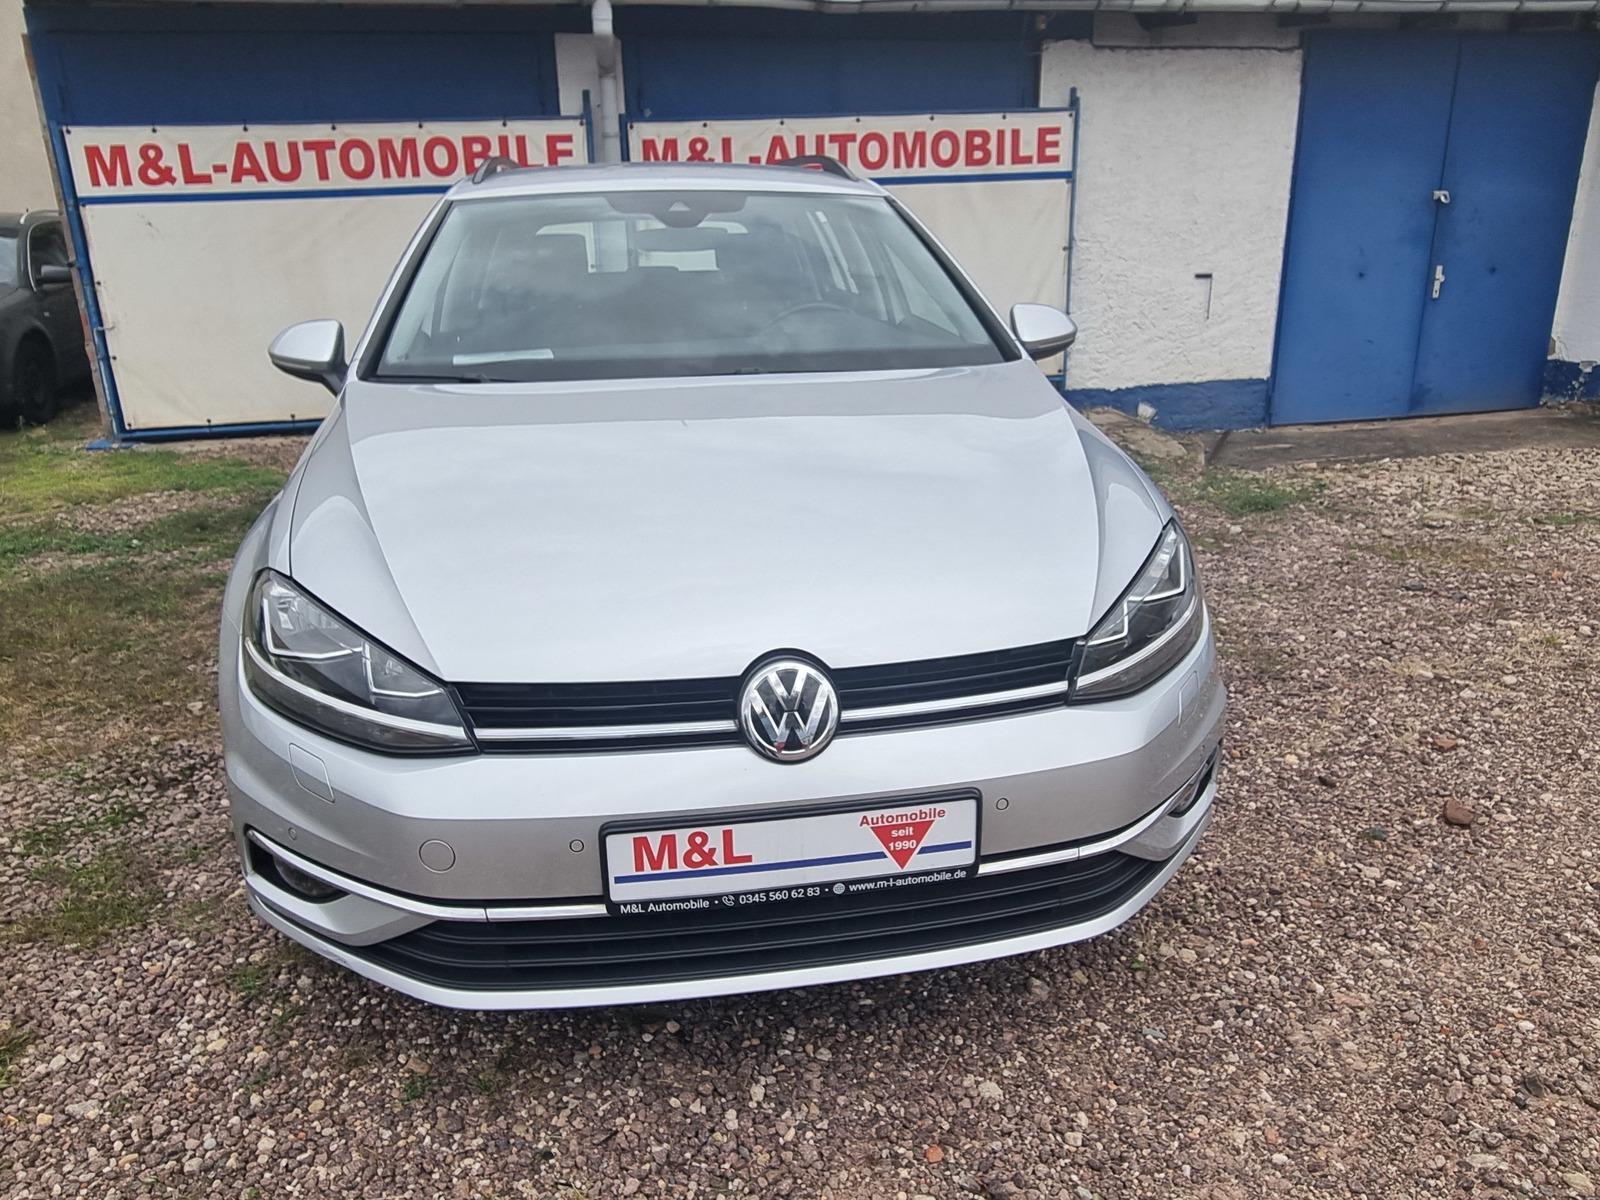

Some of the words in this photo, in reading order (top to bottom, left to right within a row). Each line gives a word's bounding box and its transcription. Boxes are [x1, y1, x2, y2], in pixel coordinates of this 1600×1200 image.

[83, 133, 574, 188] M&L-AUTOMOBILE
[743, 662, 836, 754] VW
[859, 807, 946, 828] Automobile
[890, 826, 914, 838] seit
[632, 829, 752, 872] M&L
[888, 839, 917, 852] 1990
[620, 903, 646, 915] M&L
[648, 898, 710, 913] Automobile
[739, 893, 767, 905] 0345
[769, 890, 788, 903] 560
[790, 888, 805, 900] 62
[806, 886, 821, 898] 83
[848, 869, 967, 892] www.m-l-automobile.de
